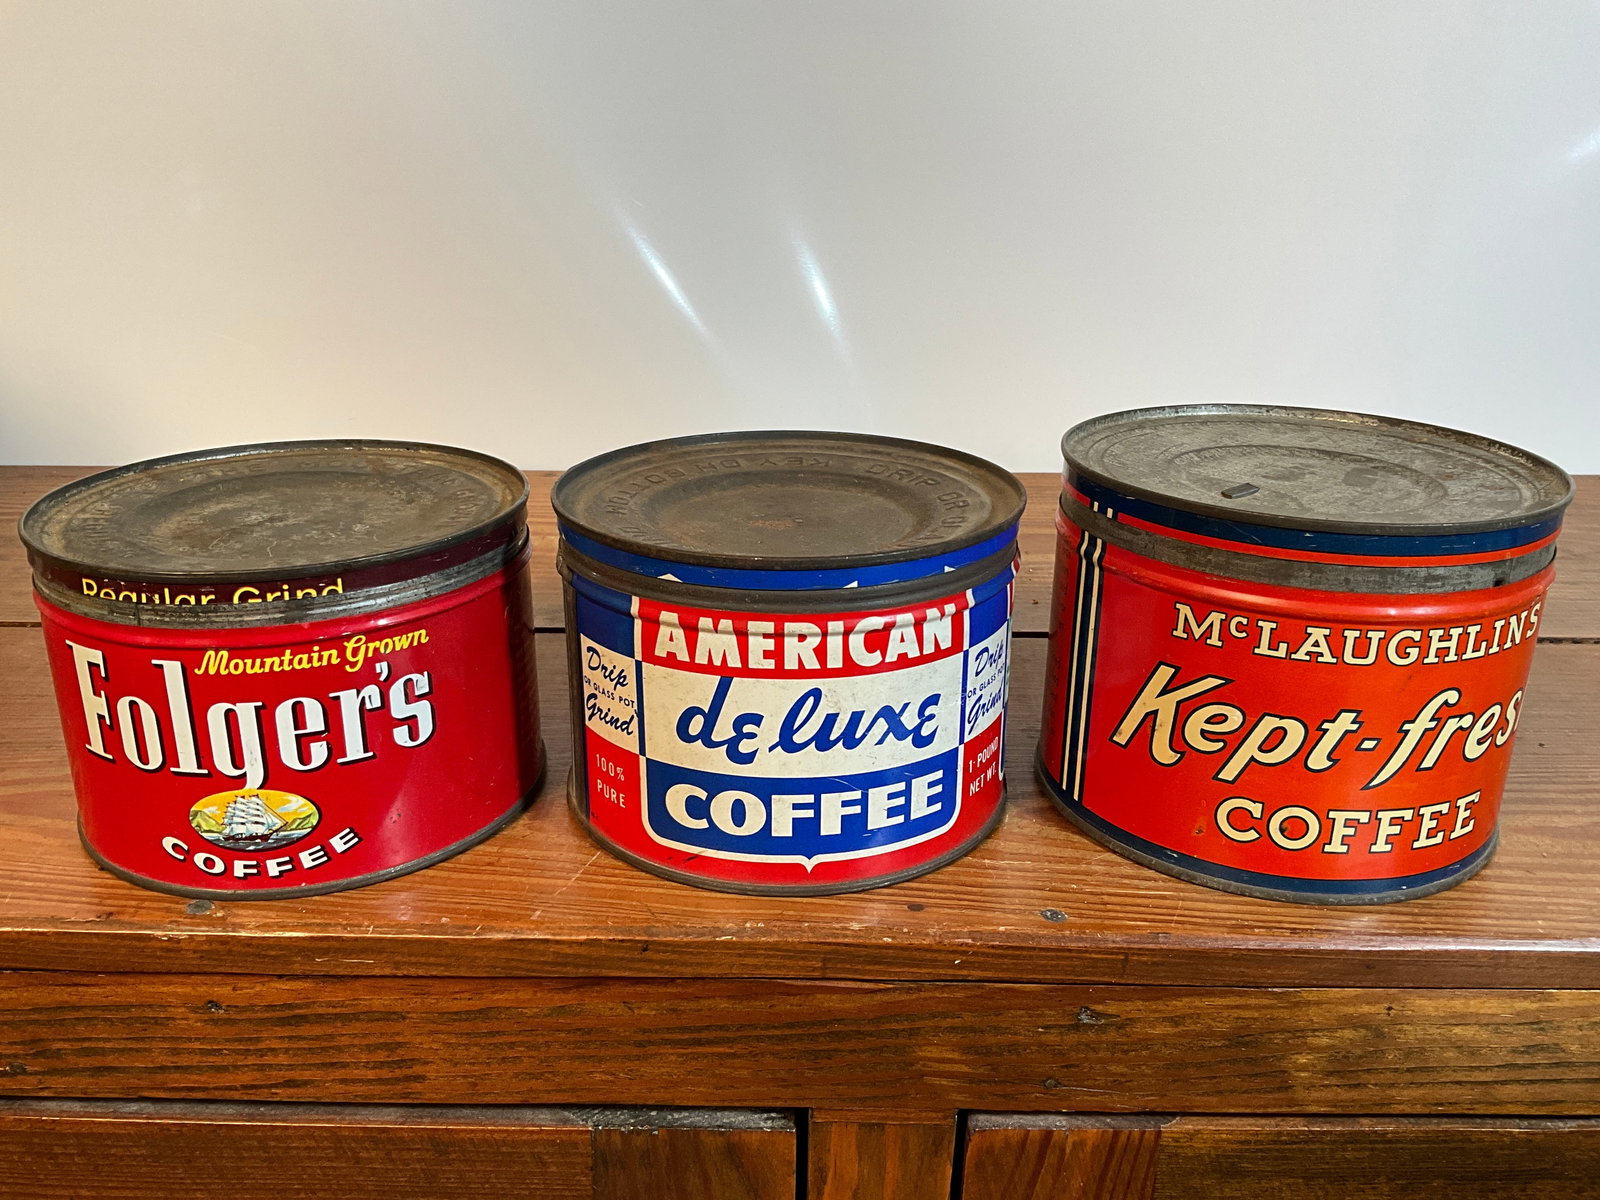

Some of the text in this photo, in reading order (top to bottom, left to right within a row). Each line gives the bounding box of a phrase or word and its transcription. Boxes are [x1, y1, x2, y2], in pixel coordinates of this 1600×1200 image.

[194, 629, 429, 675] Mountain Grown
[654, 602, 956, 671] AMERICAN
[587, 645, 628, 691] Drip
[65, 639, 435, 789] Folger's
[586, 692, 634, 736] Grind
[593, 683, 615, 700] GLASS
[619, 697, 636, 709] POT
[967, 687, 977, 698] OR
[1109, 661, 1523, 790] Kept-fres
[596, 754, 625, 781] 100%
[969, 773, 985, 797] NET
[597, 779, 626, 808] PURE
[665, 769, 944, 838] COFFEE
[1214, 791, 1480, 854] COFFEE
[162, 827, 361, 878] COFFEE
